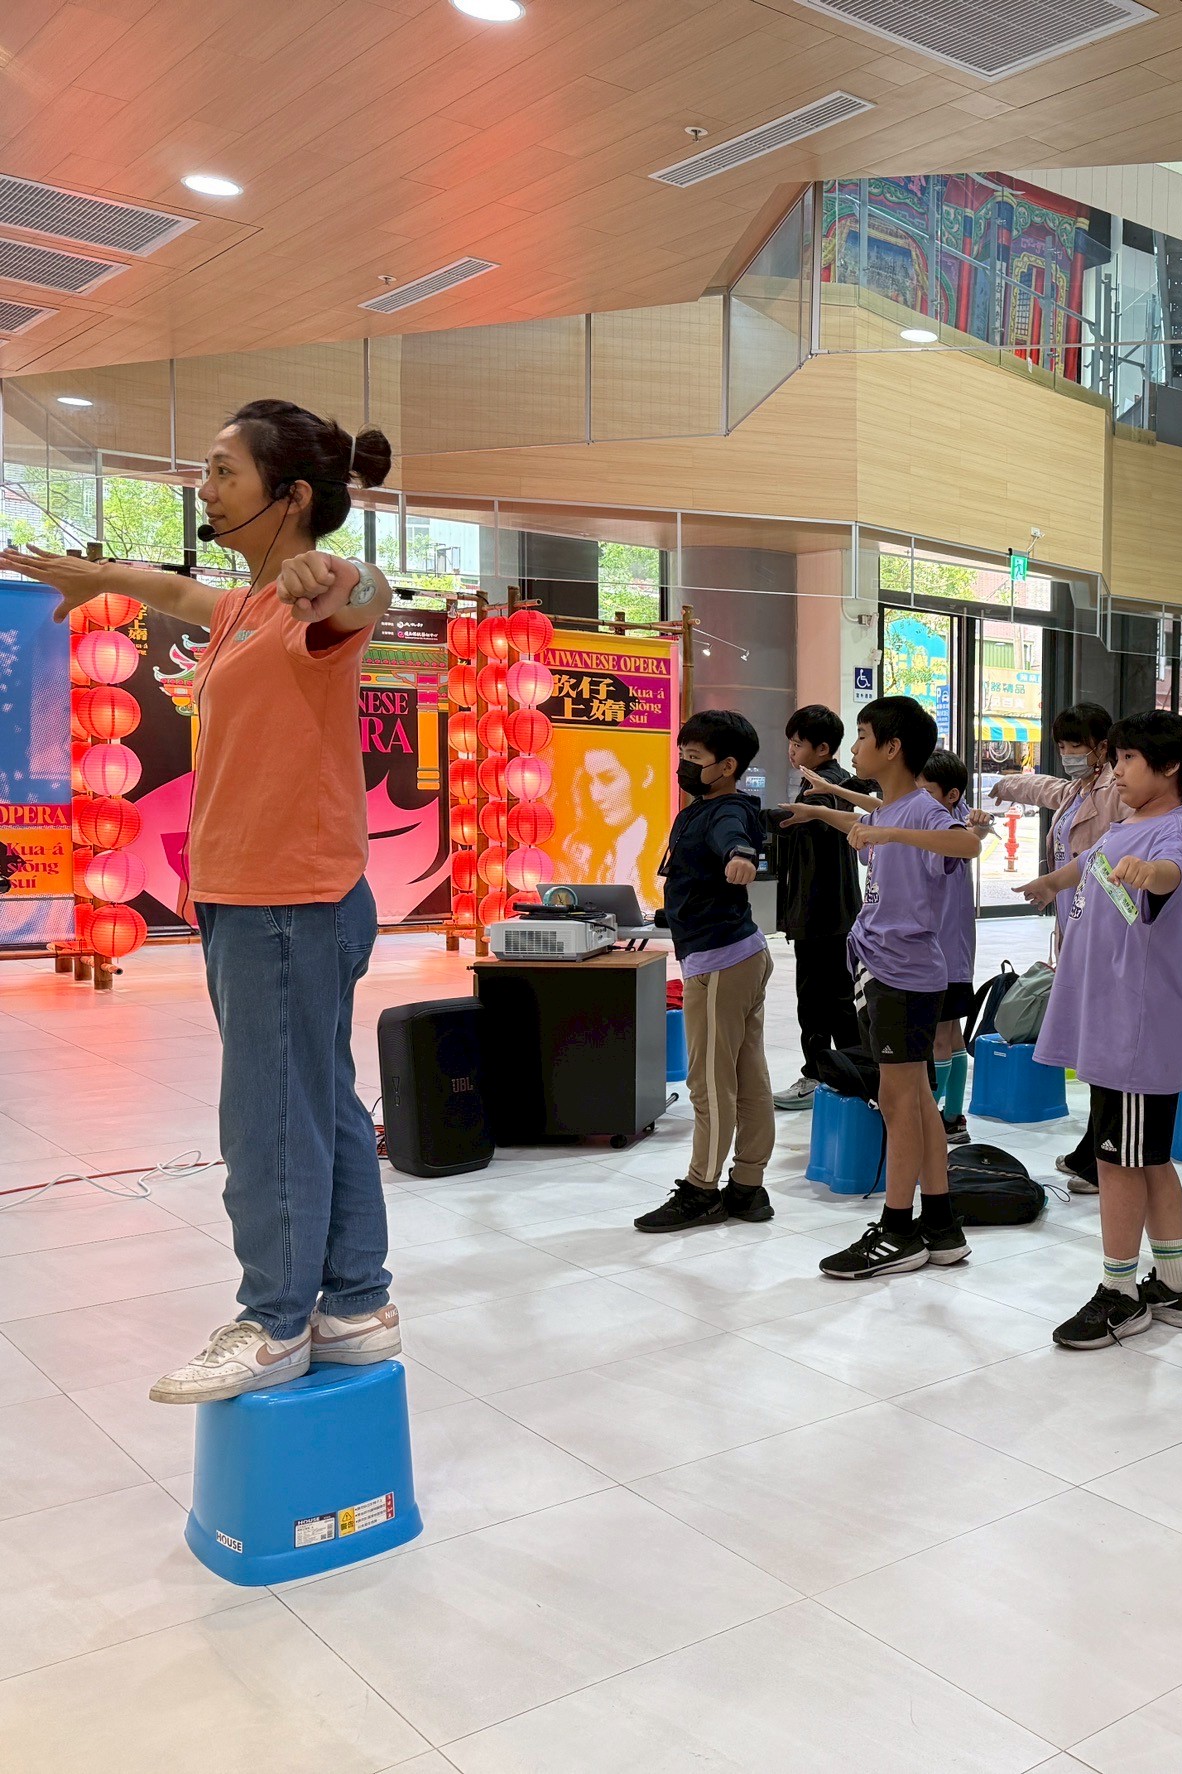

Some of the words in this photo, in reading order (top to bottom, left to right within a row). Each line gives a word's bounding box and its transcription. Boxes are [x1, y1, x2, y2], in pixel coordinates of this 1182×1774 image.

[539, 650, 618, 671] TAIWANESE
[620, 657, 667, 675] OPERA
[628, 686, 665, 700] Kua-á
[551, 697, 627, 723] 上媠
[629, 699, 662, 714] siōng
[629, 713, 648, 724] suí
[6, 842, 65, 856] Kua-á
[7, 859, 60, 875] siōng
[451, 1077, 474, 1093] JBL
[216, 1531, 242, 1552] HOUSE
